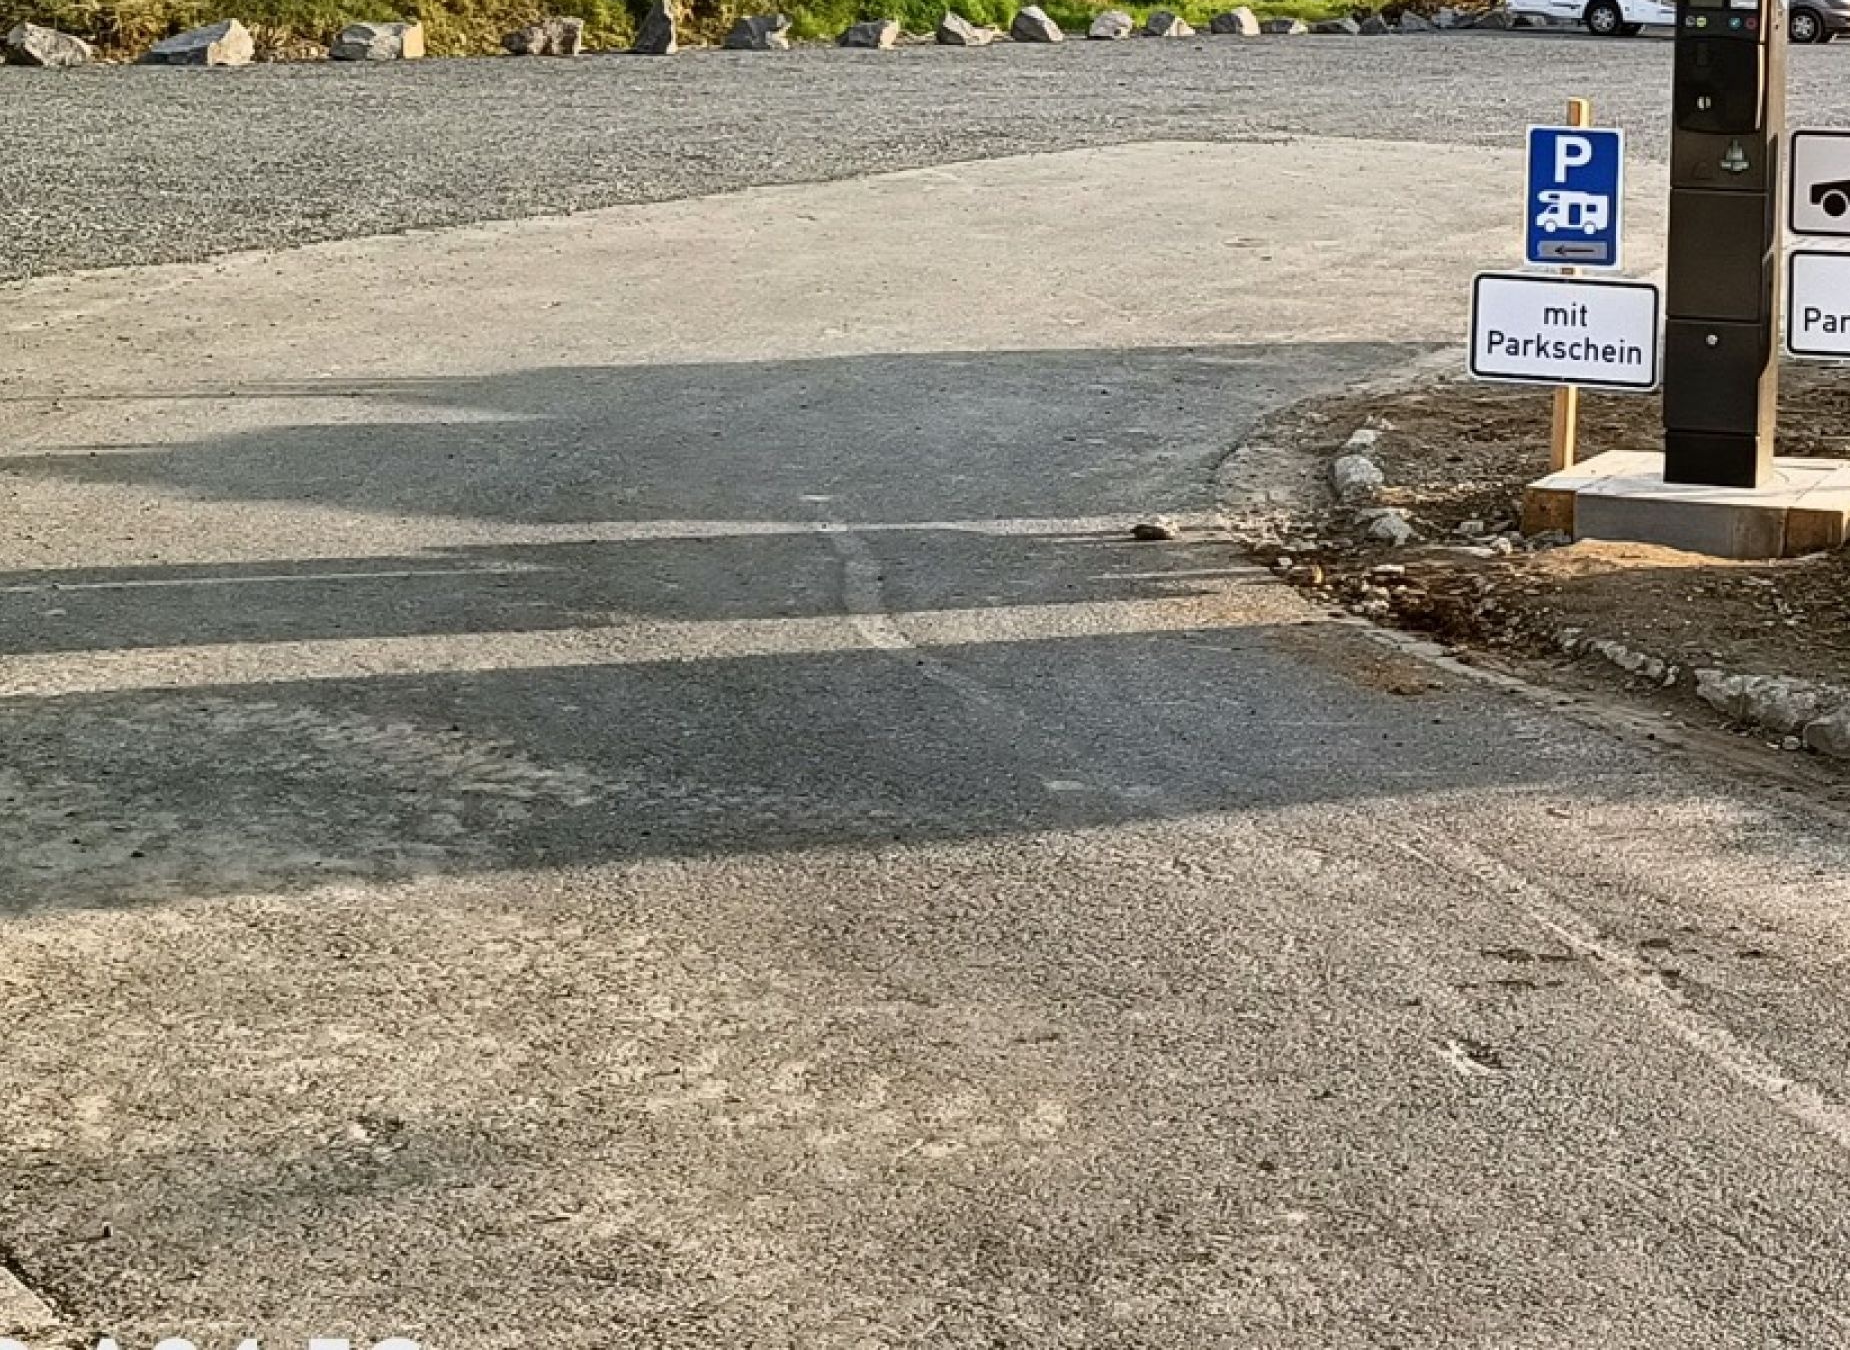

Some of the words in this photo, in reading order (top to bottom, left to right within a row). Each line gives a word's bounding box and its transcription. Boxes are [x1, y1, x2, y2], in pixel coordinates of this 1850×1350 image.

[1554, 135, 1592, 183] P
[1543, 302, 1588, 328] mit
[1486, 331, 1643, 366] Parkschein
